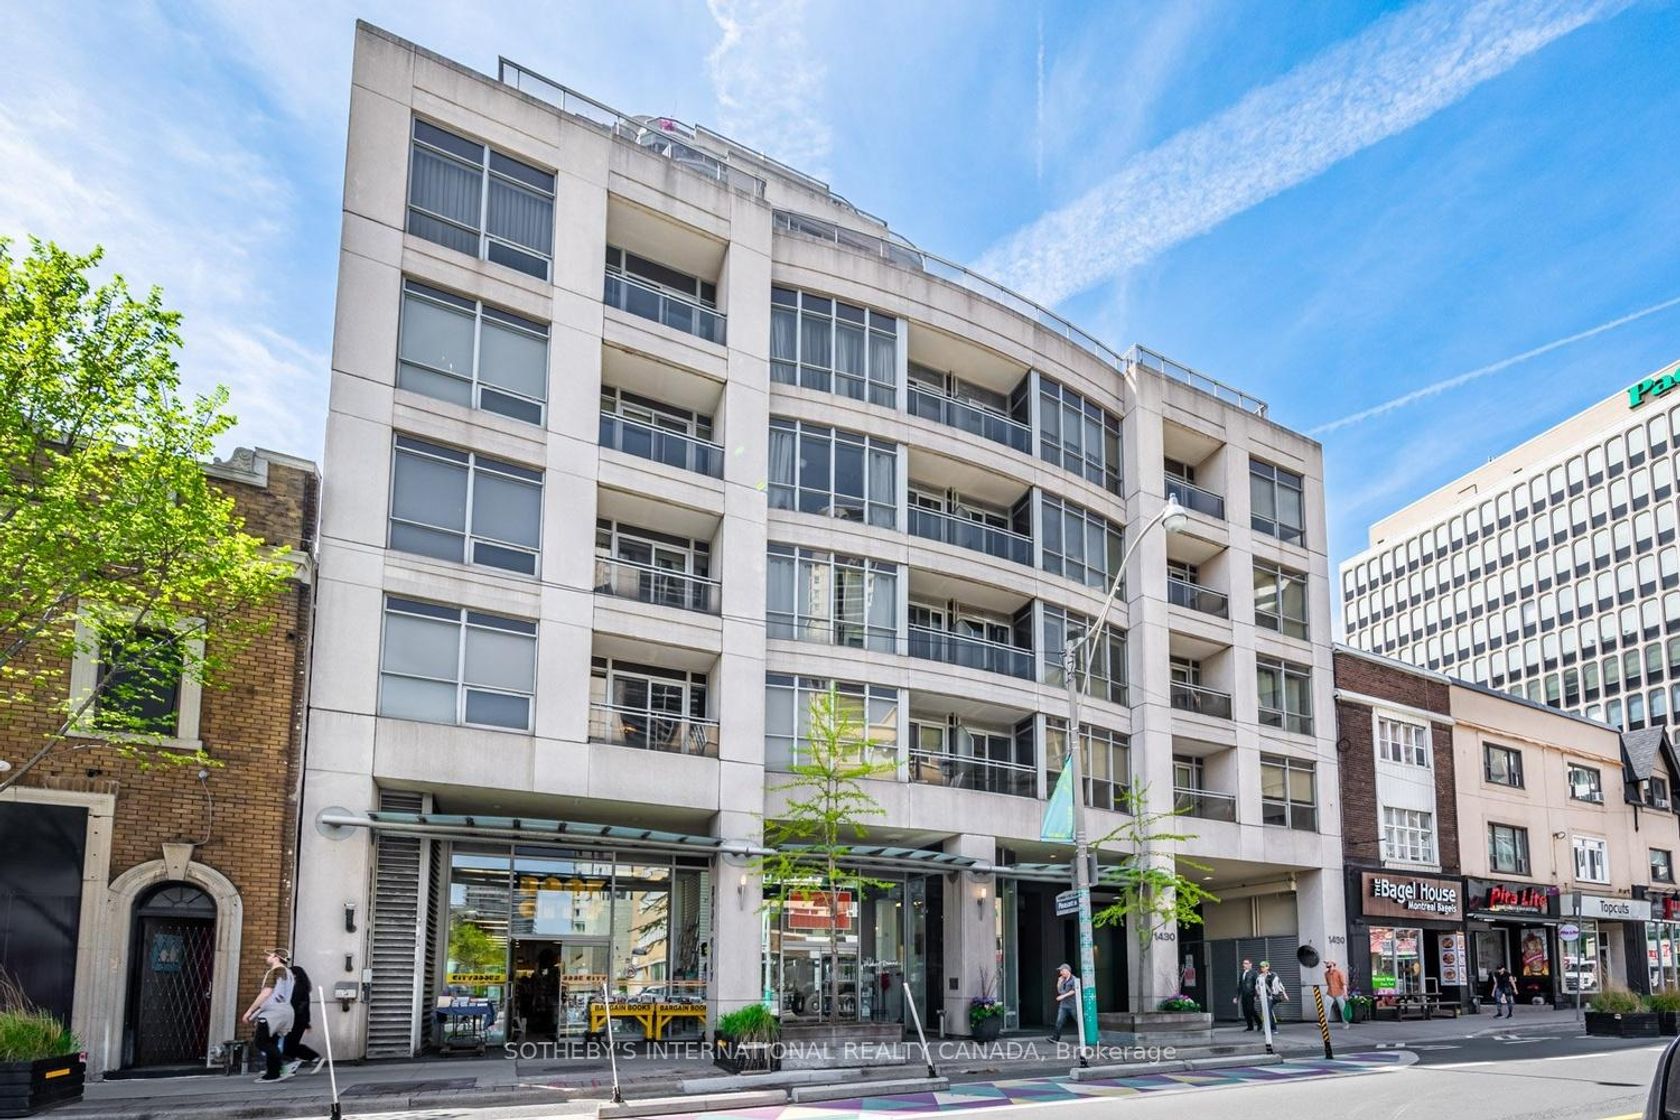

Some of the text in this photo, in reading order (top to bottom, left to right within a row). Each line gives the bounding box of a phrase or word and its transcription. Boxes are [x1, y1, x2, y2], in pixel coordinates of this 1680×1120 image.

[1381, 879, 1457, 904] Bagel House
[1407, 900, 1457, 915] Montreal Bagels
[1600, 900, 1630, 914] Topcuts
[1153, 931, 1176, 941] 1430
[594, 1003, 652, 1011] BAGAIN BOOKS
[660, 1003, 689, 1011] BARGAIN
